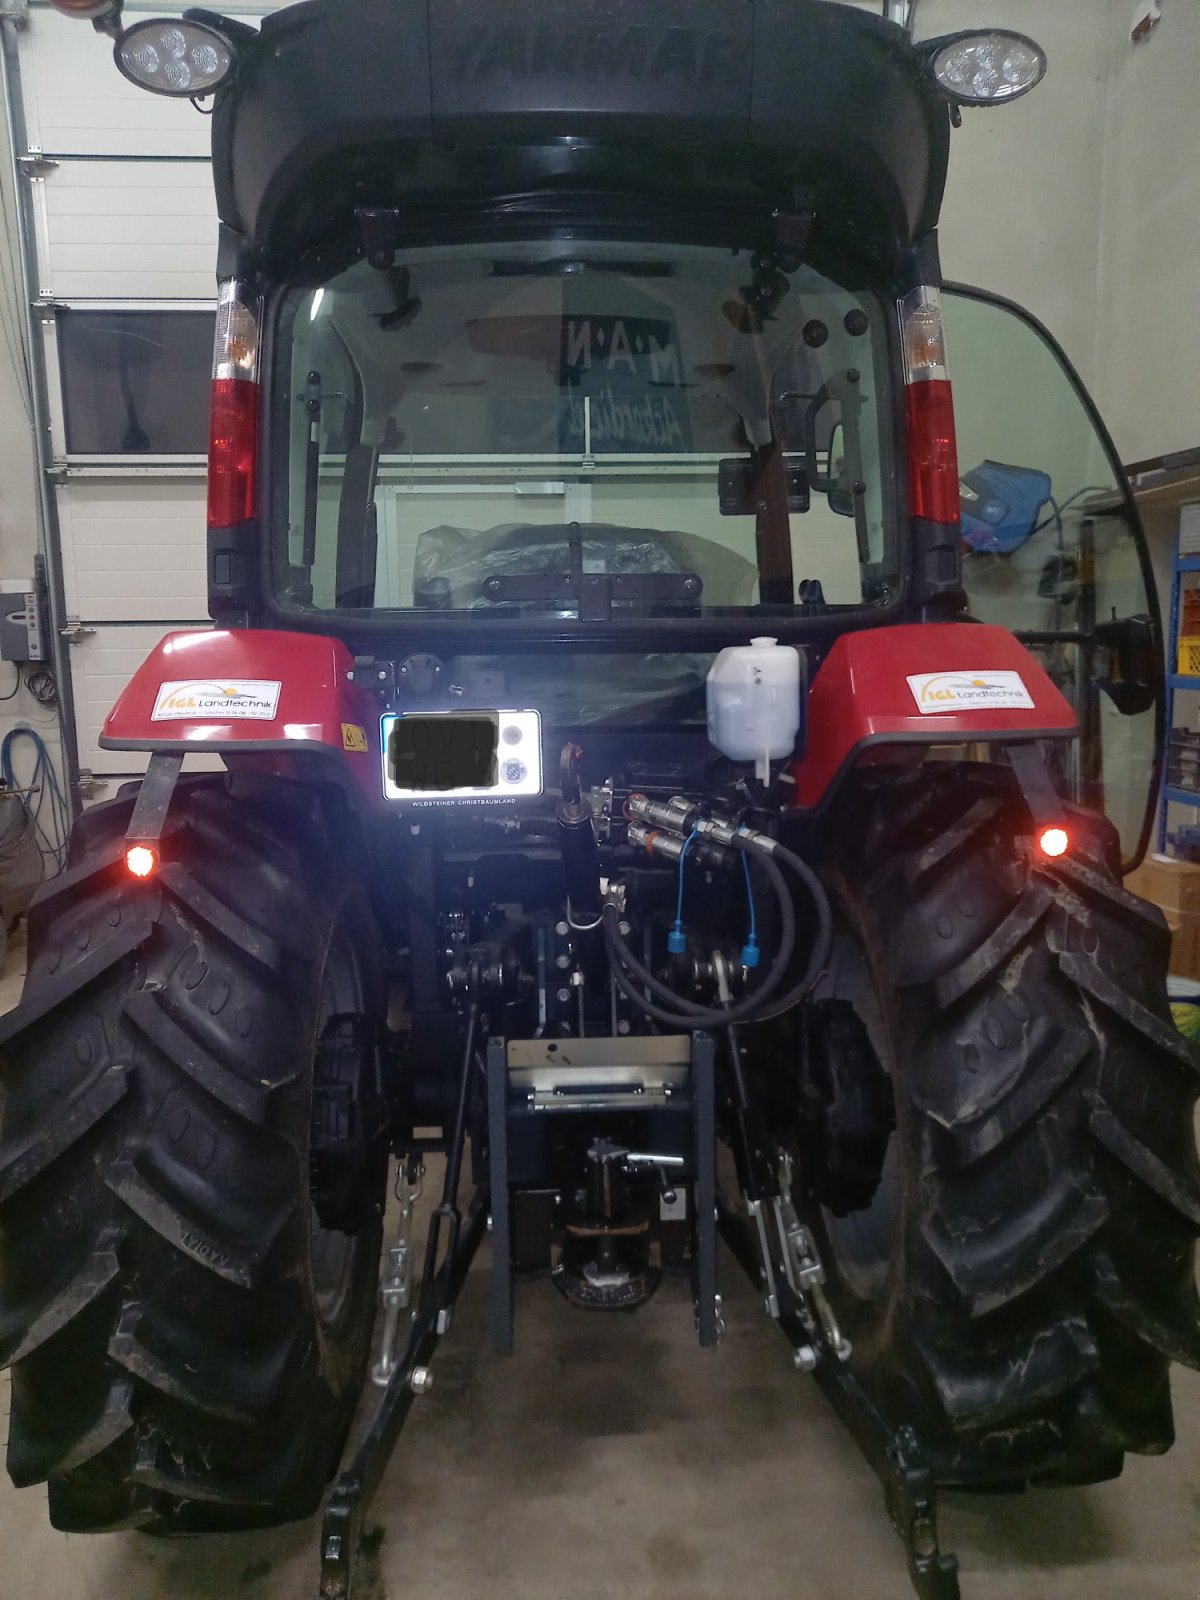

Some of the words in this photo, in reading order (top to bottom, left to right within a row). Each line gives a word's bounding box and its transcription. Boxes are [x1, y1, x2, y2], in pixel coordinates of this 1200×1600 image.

[957, 690, 1025, 699] Landtechnik
[198, 699, 272, 708] Landtechnik
[457, 798, 516, 806] CHRISTBAUMLAND
